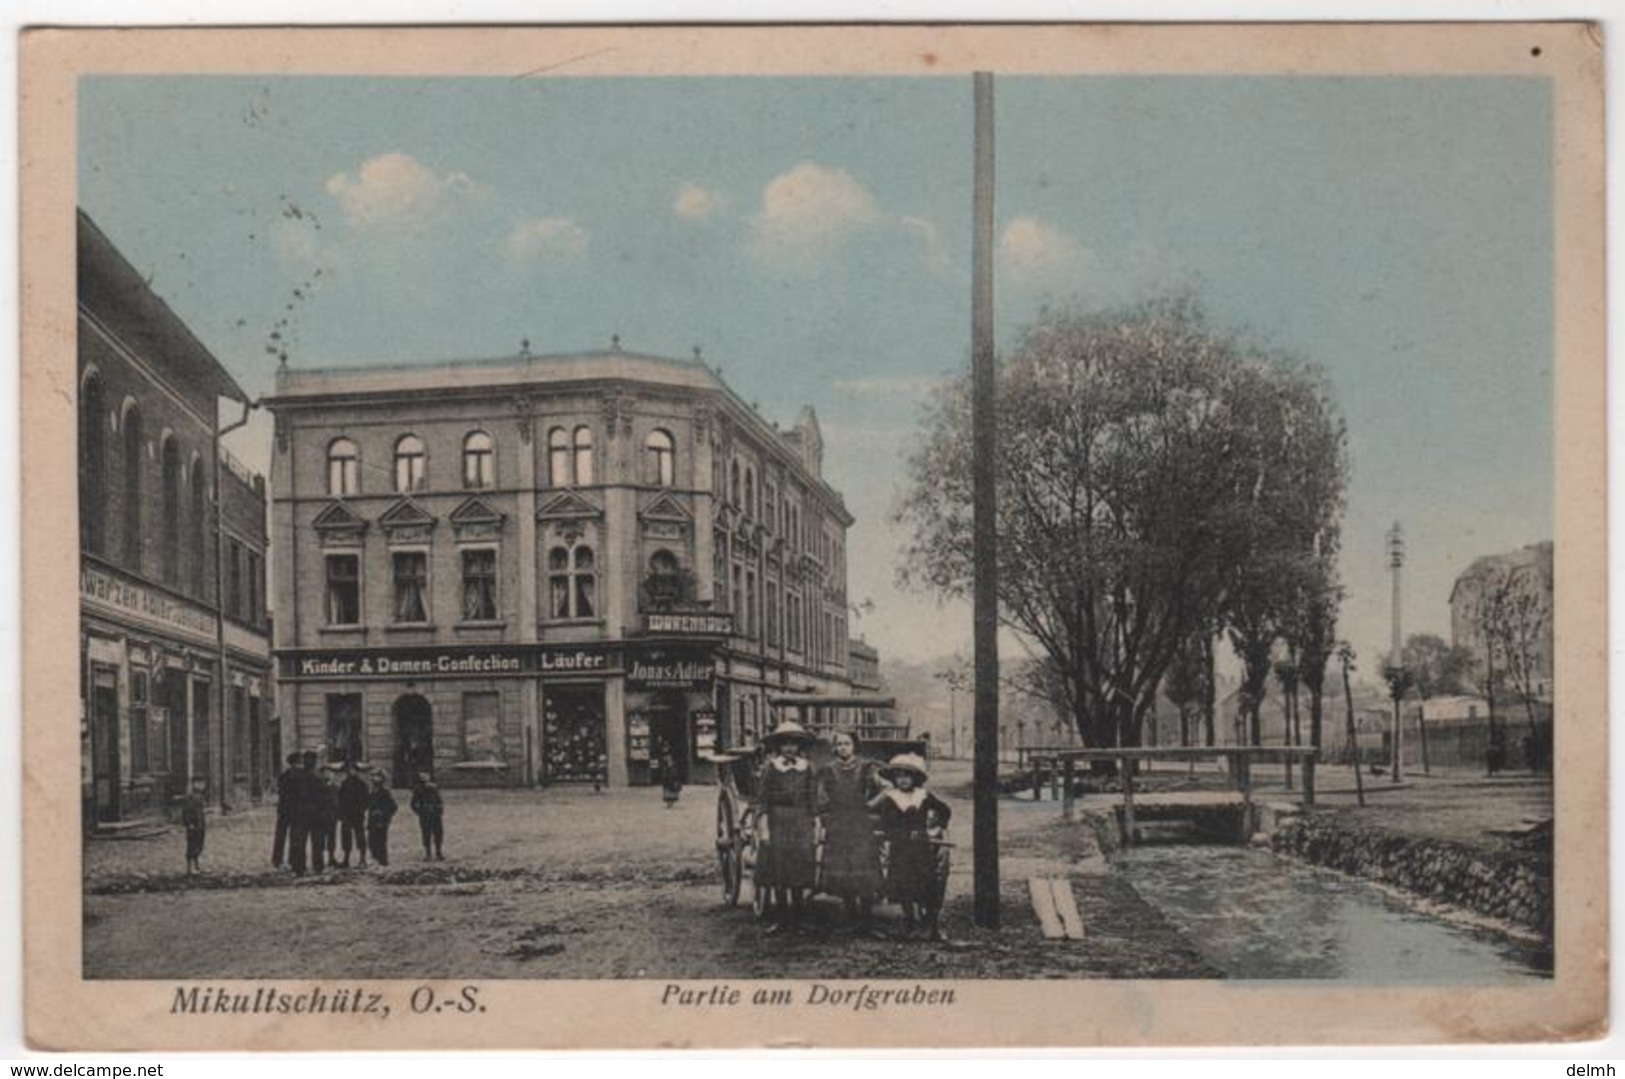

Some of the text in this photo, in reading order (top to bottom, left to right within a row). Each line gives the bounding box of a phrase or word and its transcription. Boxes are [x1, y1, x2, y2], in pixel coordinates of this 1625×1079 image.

[302, 658, 354, 674] Kinder
[360, 658, 373, 673] &
[541, 652, 604, 669] Läufer
[628, 661, 713, 680] Jonas Adler
[170, 985, 487, 1018] Mikultschütz, O.-S.
[661, 984, 956, 1011] Partie am Dorfgraben
